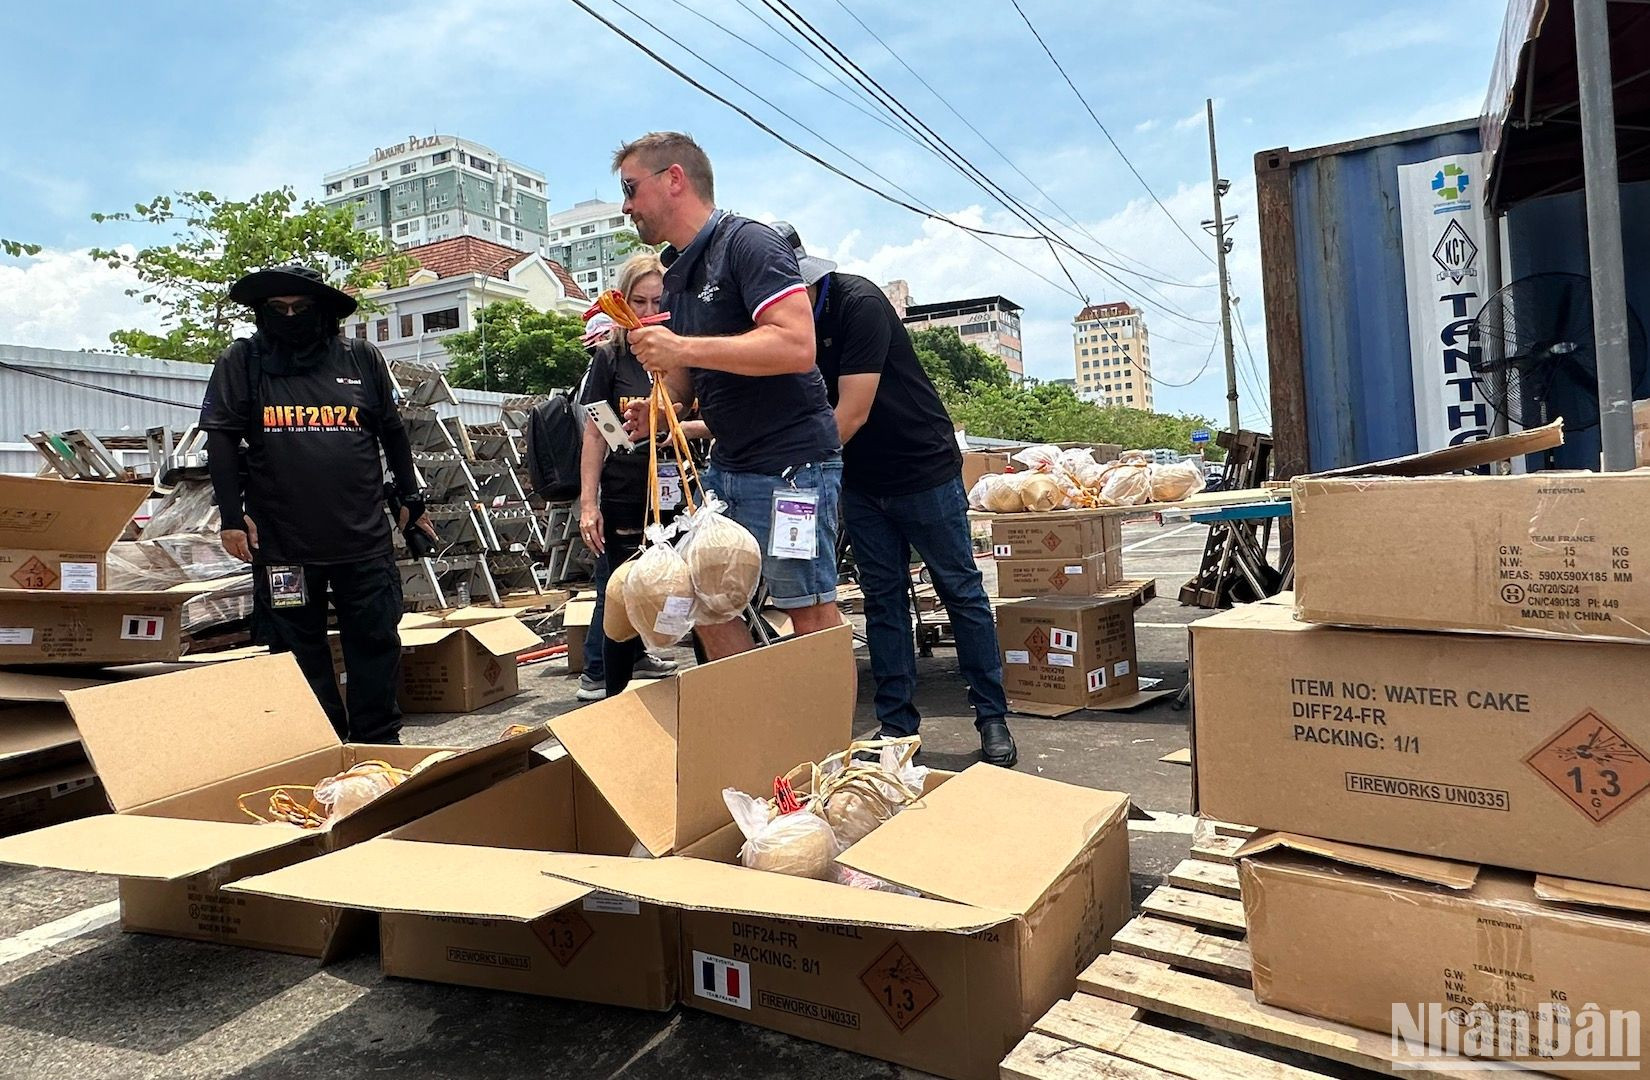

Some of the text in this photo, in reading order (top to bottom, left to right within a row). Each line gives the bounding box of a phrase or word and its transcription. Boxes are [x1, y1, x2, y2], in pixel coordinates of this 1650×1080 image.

[409, 135, 442, 151] PLAZA
[1445, 237, 1465, 266] KCT
[263, 405, 360, 427] DIFF2024
[1530, 535, 1596, 543] TEAM FRANCE
[1499, 546, 1630, 556] G.W: 15 KG
[1499, 558, 1630, 569] N.W: 14 KG
[1499, 570, 1633, 582] MEAS: 590X590X185 MM
[1527, 584, 1580, 594] 4G/Y20/S/24
[1527, 597, 1581, 607] CN/C490138
[1602, 600, 1619, 609] 449
[1521, 609, 1612, 621] MADE IN CHINA
[1291, 678, 1530, 713] ITEM NO: WATER CAKE
[1292, 702, 1387, 726] DIFF24-FR
[1294, 724, 1420, 754] PACKING: 1/1
[1350, 775, 1505, 808] FIREWORKS UN0335
[1567, 766, 1621, 797] 1.3
[1476, 917, 1523, 931] ARTEVENTIA
[549, 928, 574, 949] 1.3
[732, 921, 798, 949] DIFF24-FR
[449, 950, 497, 965] FIREWORKS
[733, 943, 820, 976] PACKING: 8/1
[1444, 968, 1516, 991] G.W: 15
[1472, 963, 1535, 982] TEAM FRANCE
[883, 985, 915, 1012] 1.3
[1444, 980, 1468, 993] N.W:
[1550, 989, 1567, 1001] KG
[761, 993, 857, 1027] FIREWORKS UN0335
